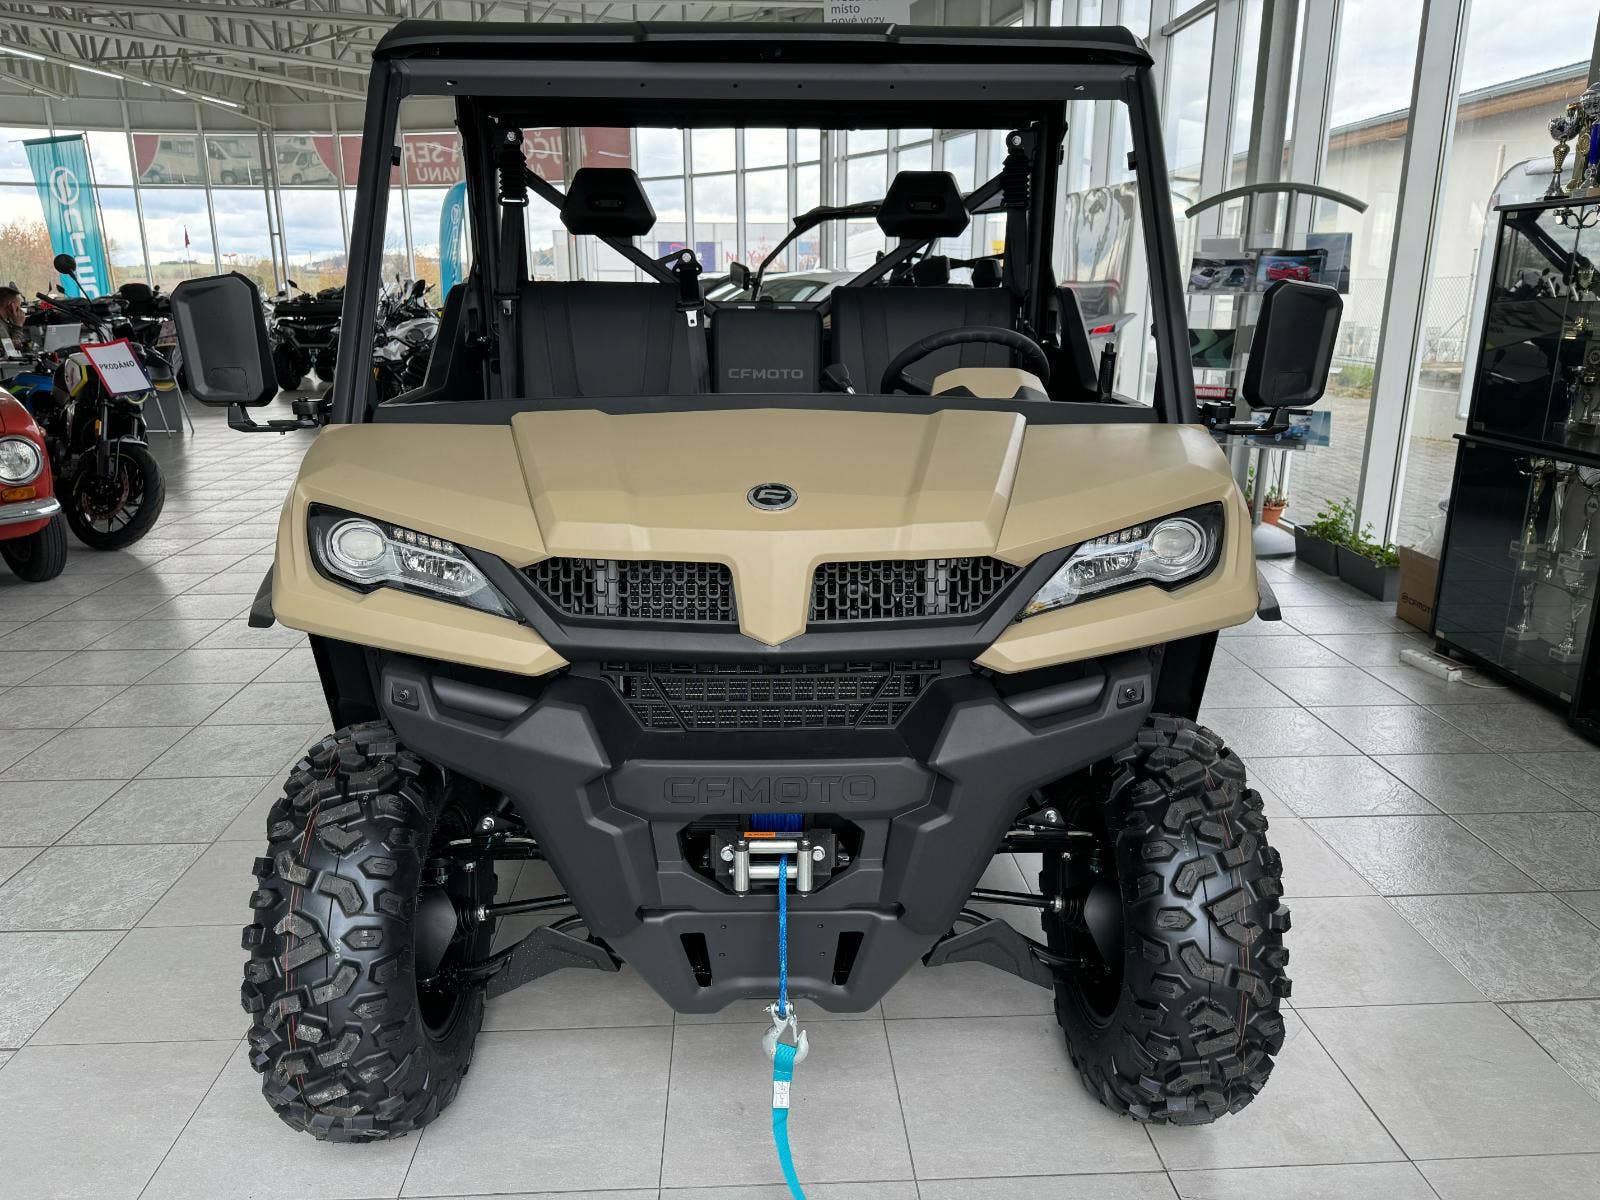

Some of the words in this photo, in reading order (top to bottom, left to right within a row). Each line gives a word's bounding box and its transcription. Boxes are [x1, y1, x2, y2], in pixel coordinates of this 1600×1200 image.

[831, 4, 860, 14] místo
[98, 360, 135, 370] PRODÁNO
[728, 368, 803, 379] CFMOTO
[664, 774, 876, 804] CFMOTO
